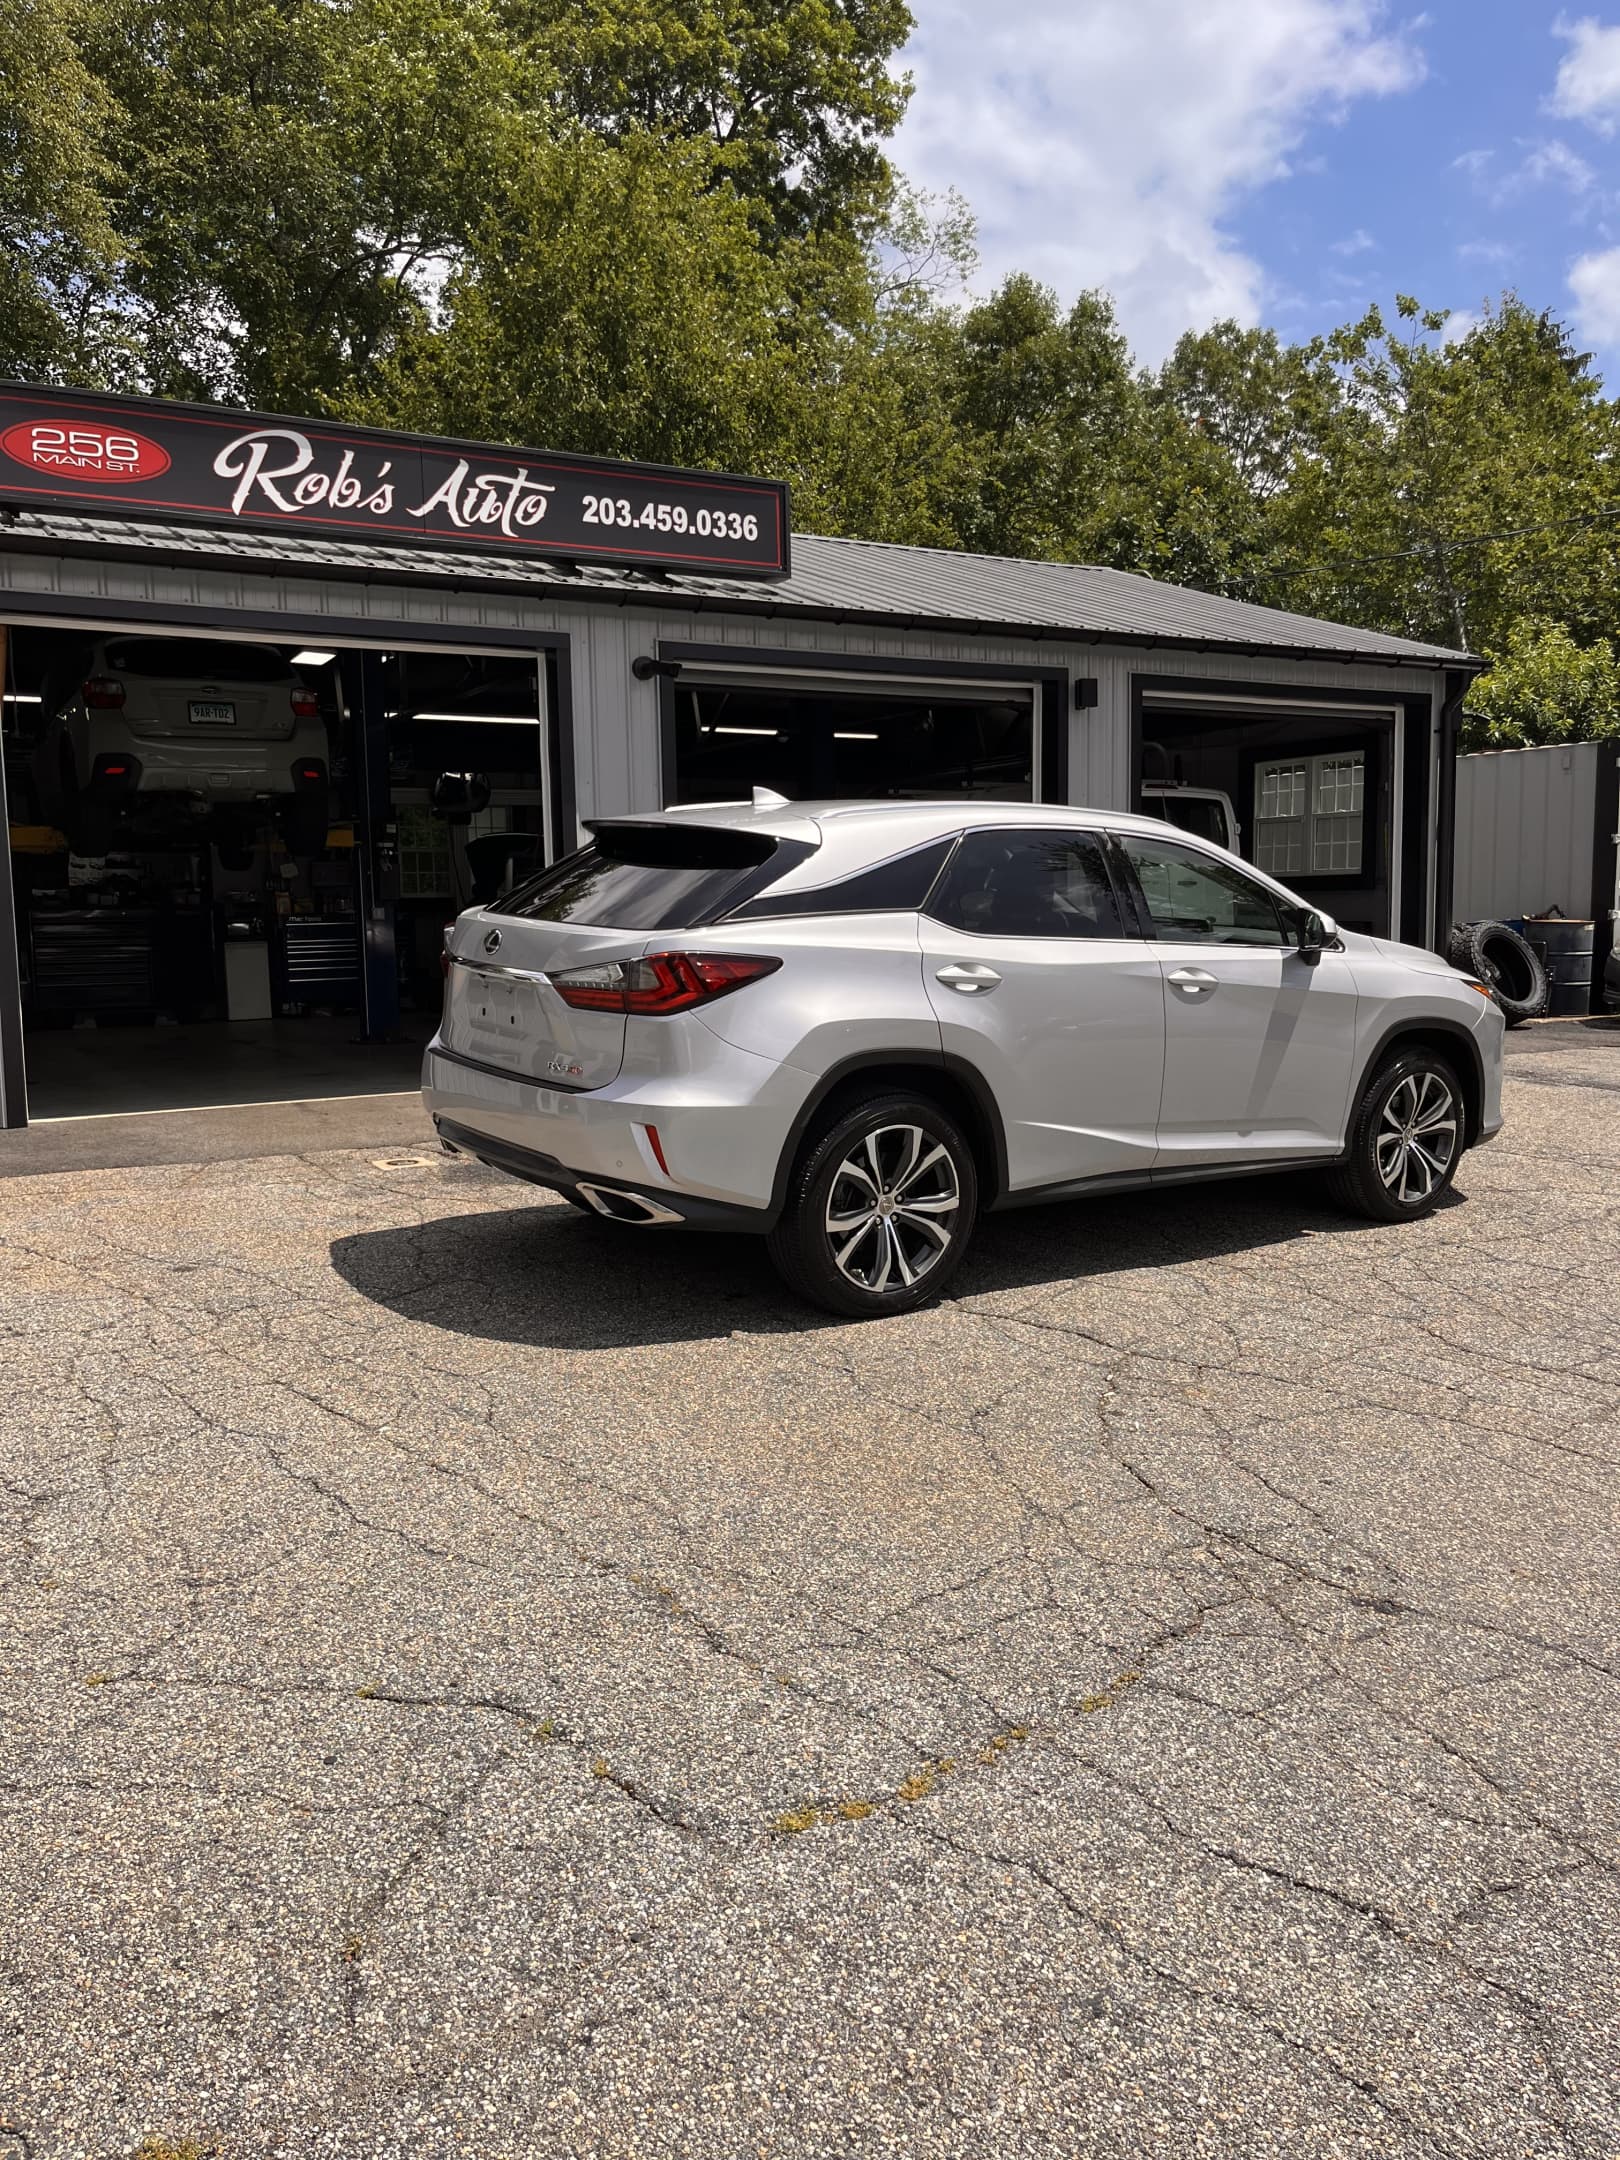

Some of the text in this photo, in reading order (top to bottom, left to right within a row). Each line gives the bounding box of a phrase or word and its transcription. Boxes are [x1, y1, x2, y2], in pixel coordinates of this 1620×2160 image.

[31, 427, 140, 461] 256
[33, 452, 141, 474] MAIN ST.
[212, 429, 556, 538] Rob's Auto
[581, 495, 759, 542] 203.459.0336
